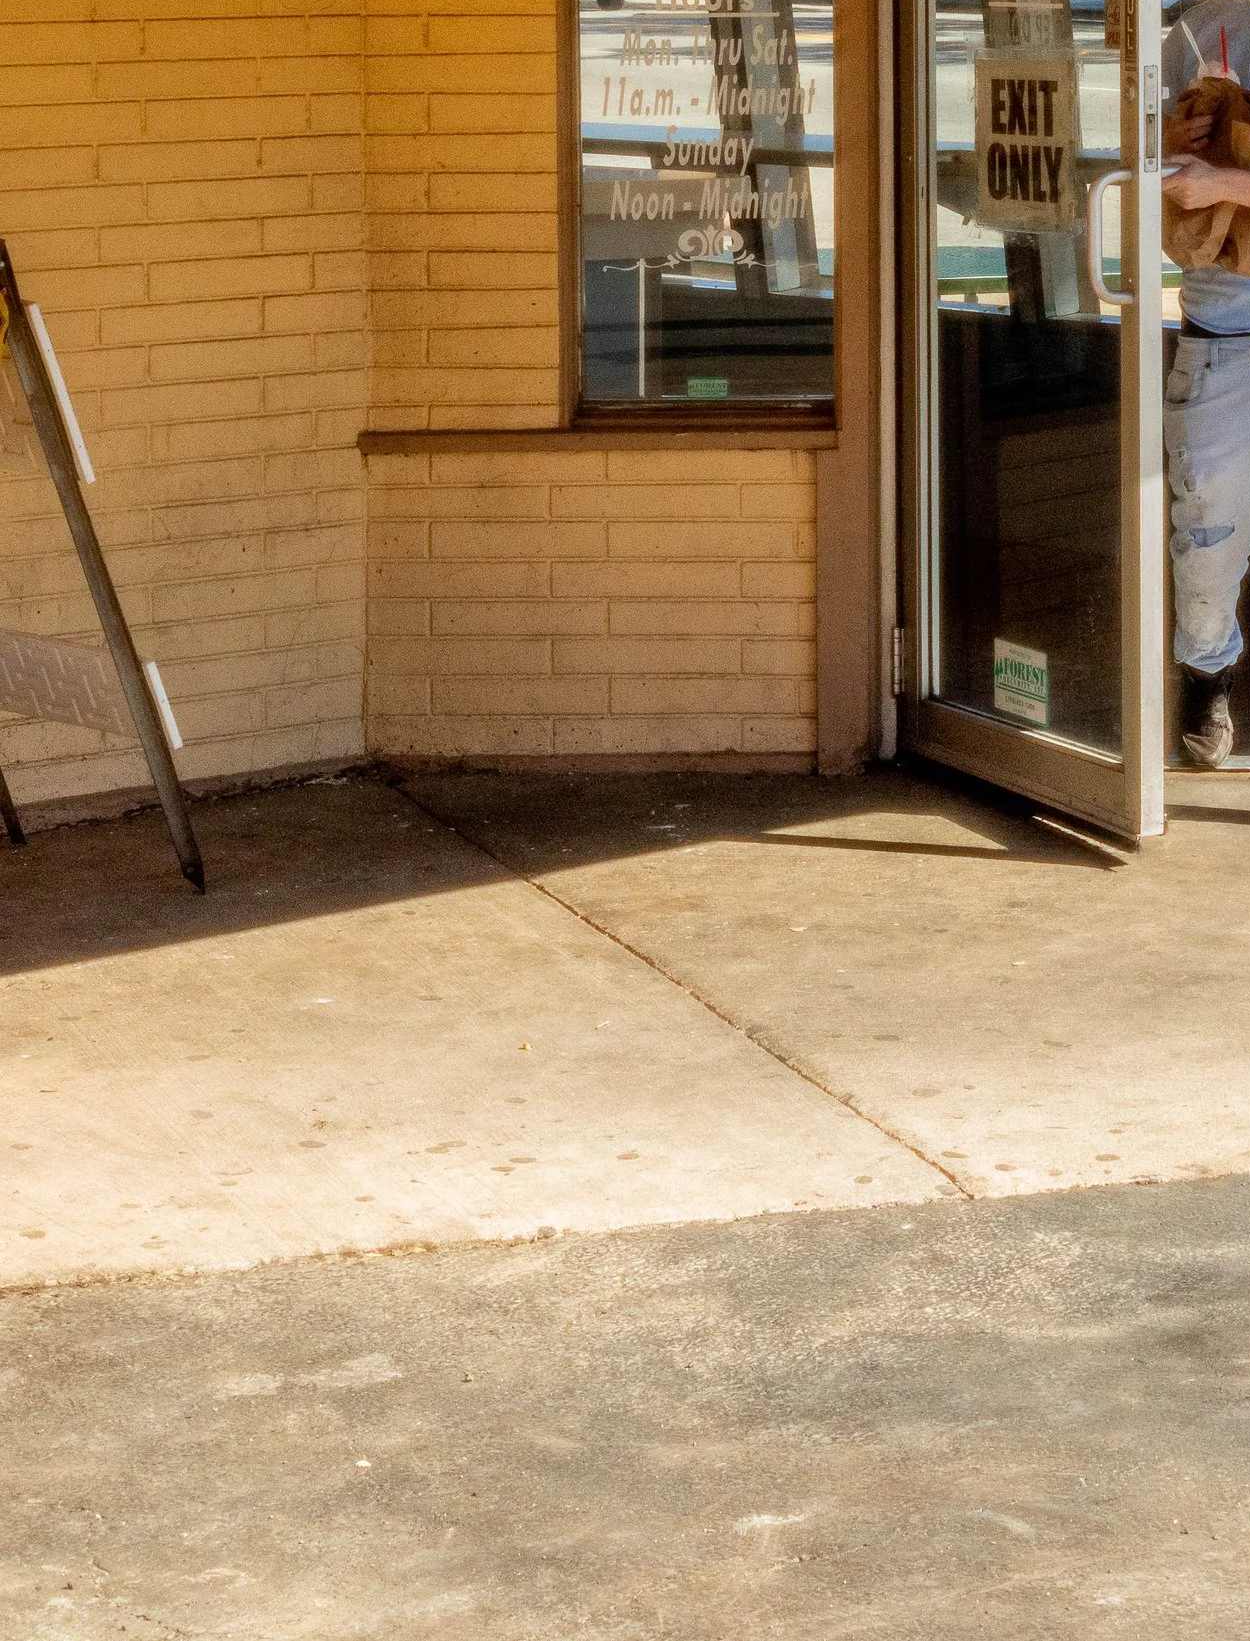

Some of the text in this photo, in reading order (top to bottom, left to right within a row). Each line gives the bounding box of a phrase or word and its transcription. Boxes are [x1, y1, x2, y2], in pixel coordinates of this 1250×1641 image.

[620, 24, 794, 66] Mon. Thru Sat.
[706, 74, 816, 127] Midnight
[990, 78, 1058, 137] EXIT
[662, 123, 755, 177] Sunday
[987, 142, 1064, 203] ONLY
[609, 180, 675, 221] Noon
[699, 175, 810, 229] Midnight
[1004, 657, 1046, 687] FOREST
